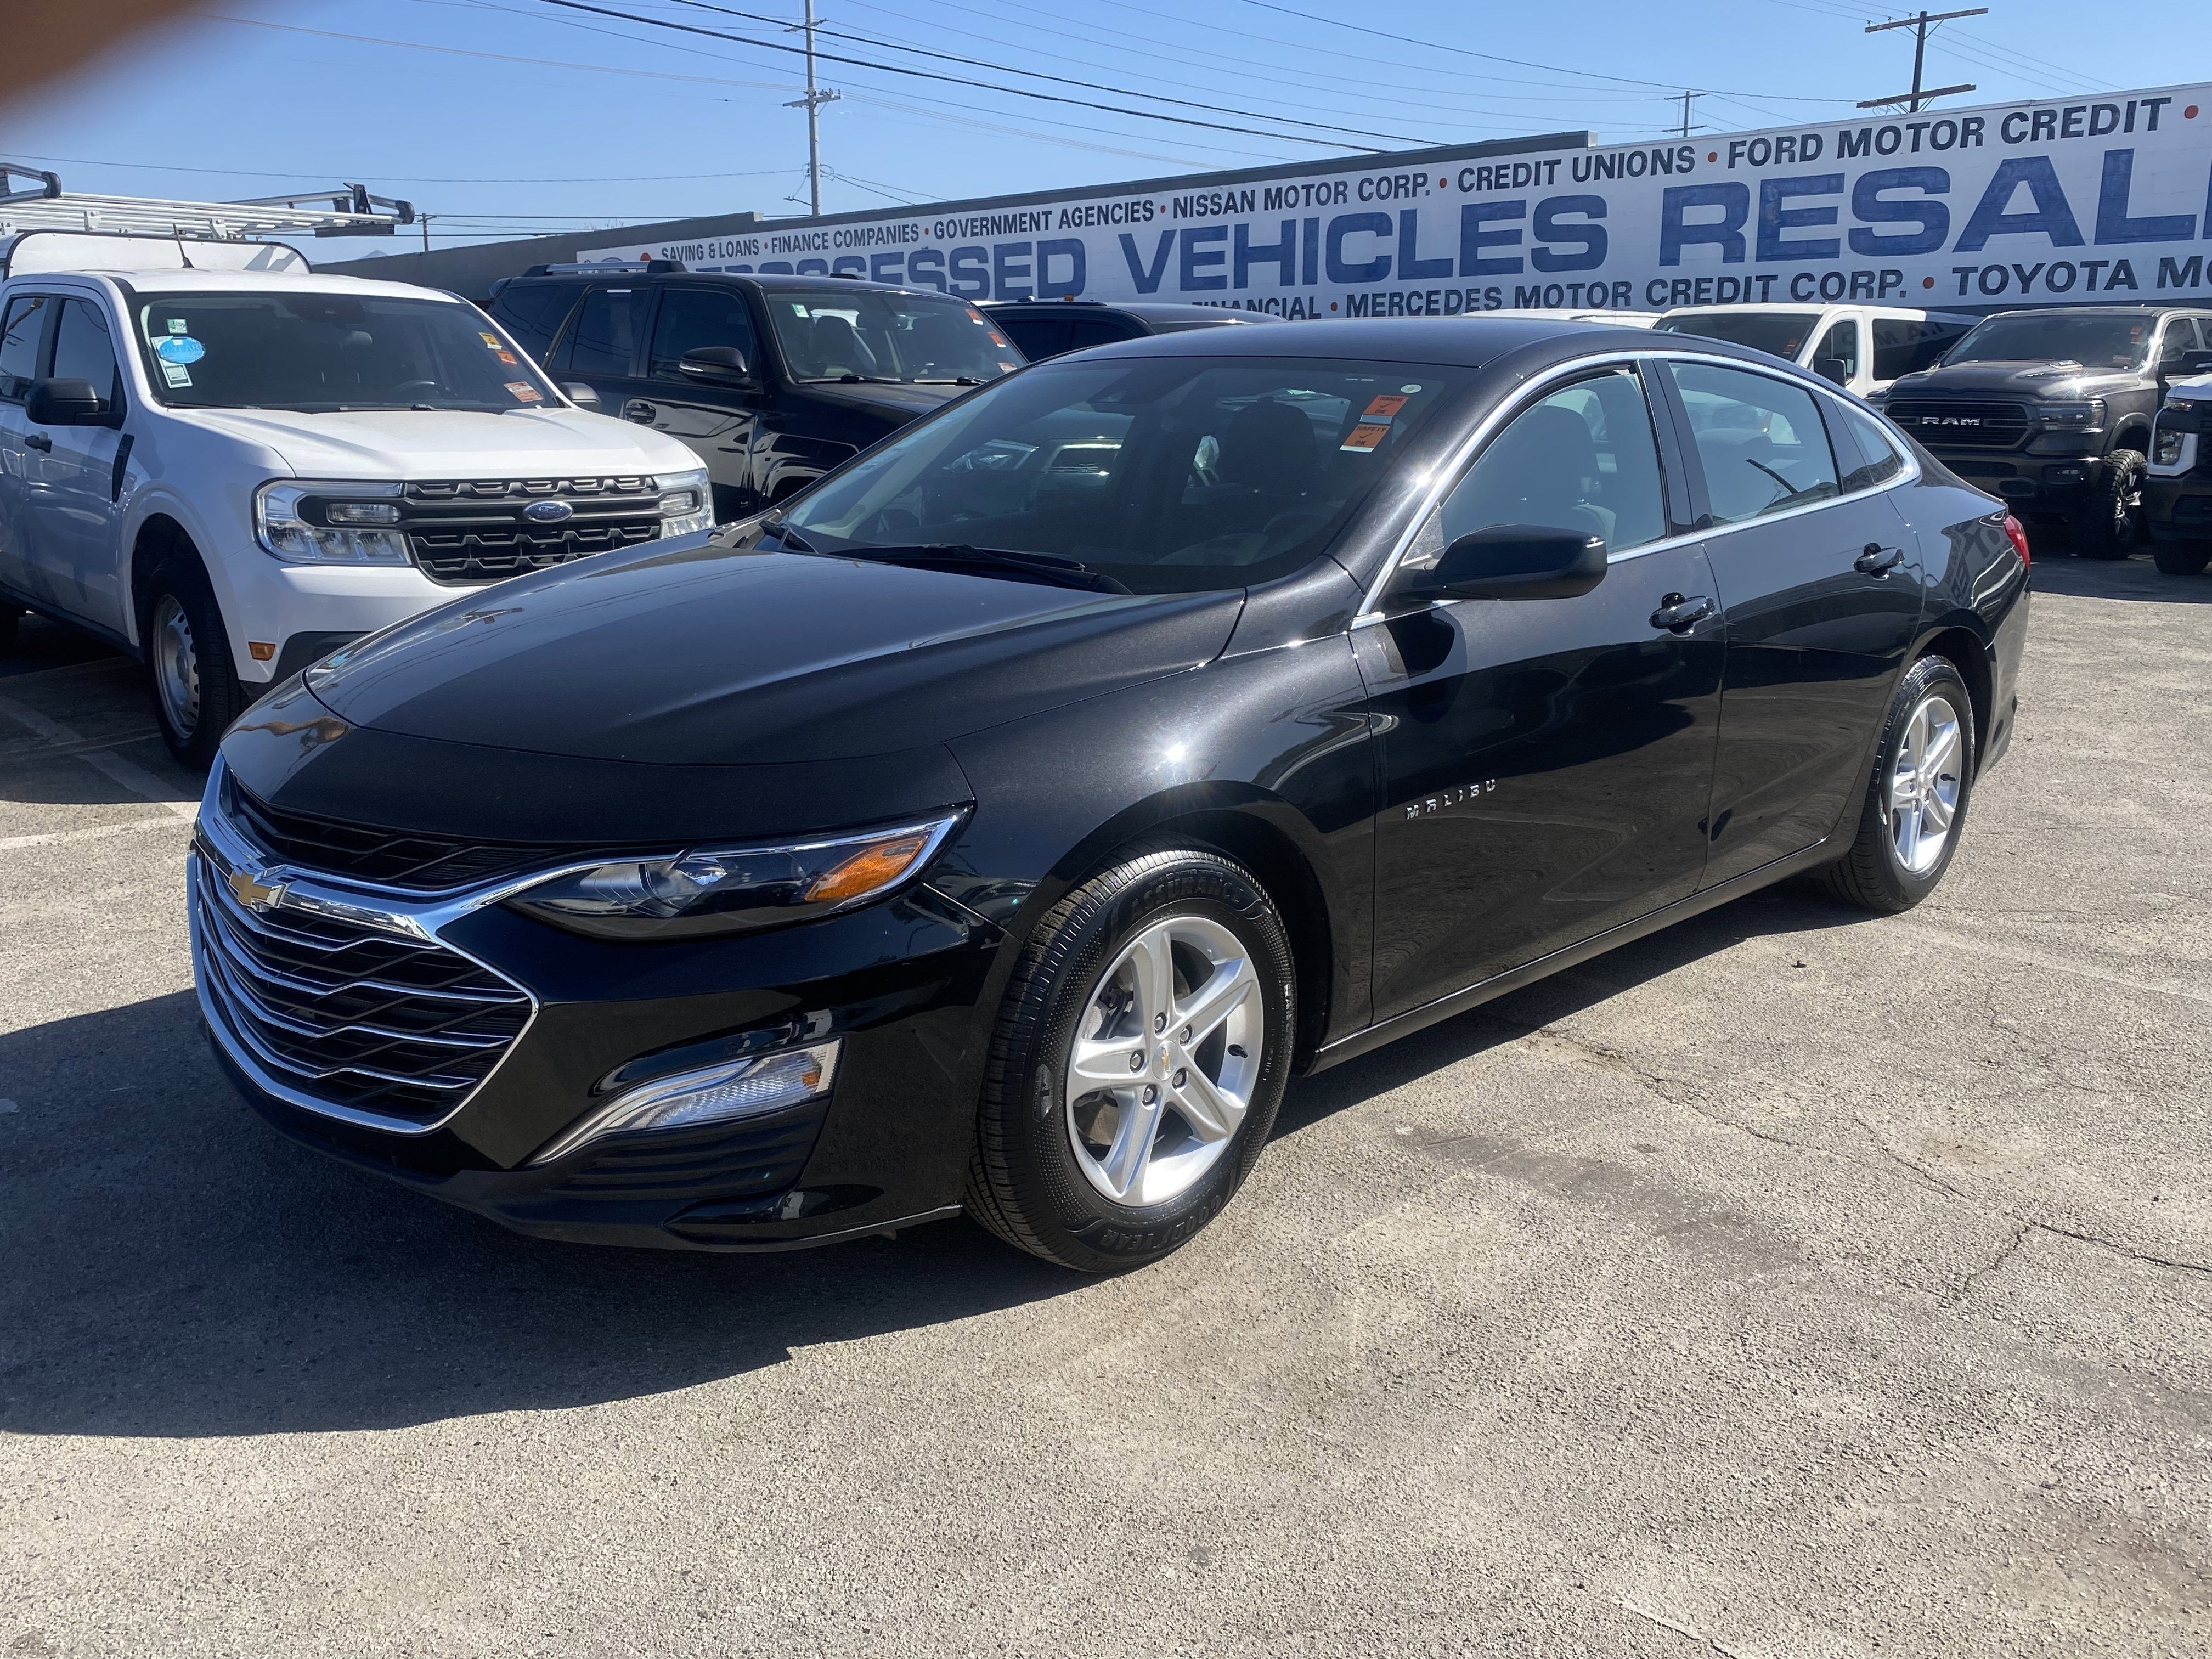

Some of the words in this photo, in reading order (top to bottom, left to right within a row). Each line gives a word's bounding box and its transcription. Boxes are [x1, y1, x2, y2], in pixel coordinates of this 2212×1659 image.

[662, 244, 704, 261] SAVING
[708, 243, 715, 259] &
[719, 239, 760, 258] LOANS
[771, 232, 828, 253] FINANCE
[833, 223, 919, 248] COMPANIES
[934, 210, 1052, 239] GOVERNMENT
[1058, 200, 1154, 229] AGENCIES
[1173, 189, 1256, 219] NISSAN
[1264, 180, 1348, 211] MOTOR
[1358, 173, 1430, 200] CORP.
[1458, 159, 1562, 193] CREDIT
[1572, 146, 1695, 183] UNIONS
[1728, 133, 1824, 169] FORD
[1837, 117, 1985, 159] MOTOR
[2001, 97, 2172, 144] CREDIT
[1118, 195, 1609, 294] VEHICLES
[1659, 148, 2212, 266] RESAL
[1346, 286, 1502, 318] MERCEDES
[1514, 281, 1632, 309] MOTOR
[1646, 275, 1778, 306] CREDIT
[1790, 269, 1906, 302] CORP.
[1952, 259, 2139, 296] TOYOTA
[2157, 256, 2212, 289] M
[1406, 778, 1496, 820] MALIBU
